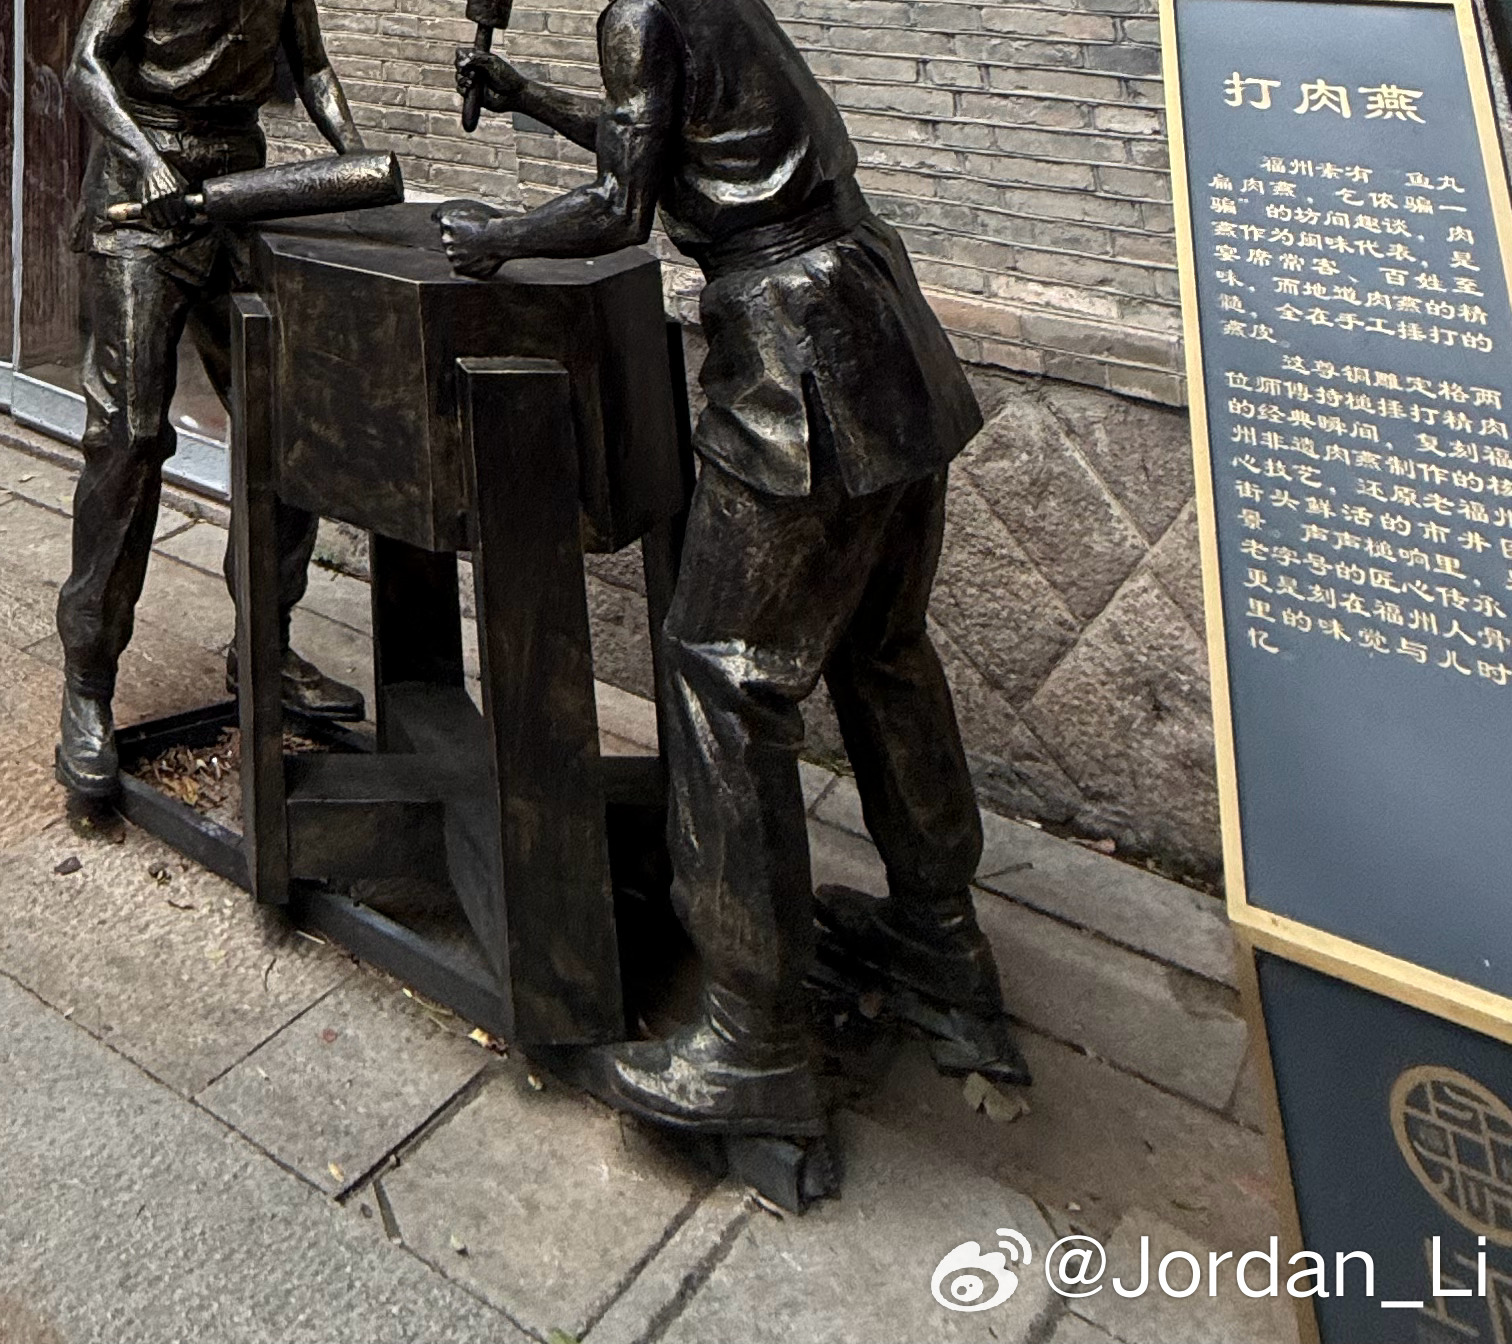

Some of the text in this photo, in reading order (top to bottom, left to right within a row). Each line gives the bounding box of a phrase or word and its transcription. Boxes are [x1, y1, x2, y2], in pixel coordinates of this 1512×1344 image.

[1223, 71, 1426, 124] 打肉燕
[1281, 354, 1502, 410] 这尊铜雕定格两
[1247, 627, 1279, 654] 忆
